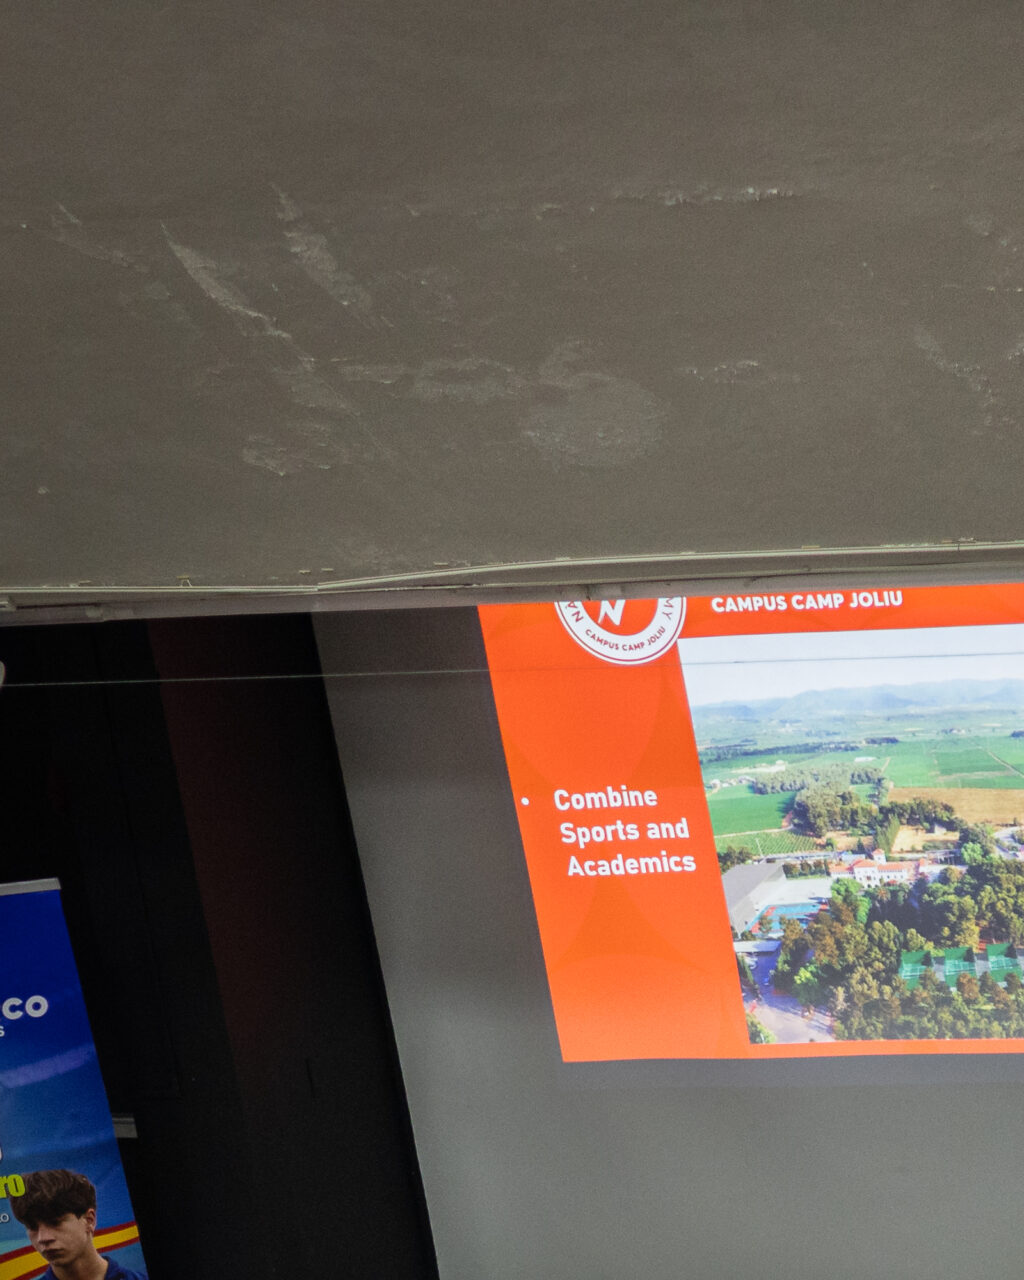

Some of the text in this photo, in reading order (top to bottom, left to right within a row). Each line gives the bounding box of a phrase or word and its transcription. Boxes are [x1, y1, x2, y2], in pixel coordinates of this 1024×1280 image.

[711, 590, 903, 613] CAMPUS CAMP JOLIU
[585, 626, 667, 652] CAMPUS CAMP JOLIU
[553, 784, 658, 811] Combine
[560, 817, 690, 849] Sports and
[567, 850, 697, 876] Academics
